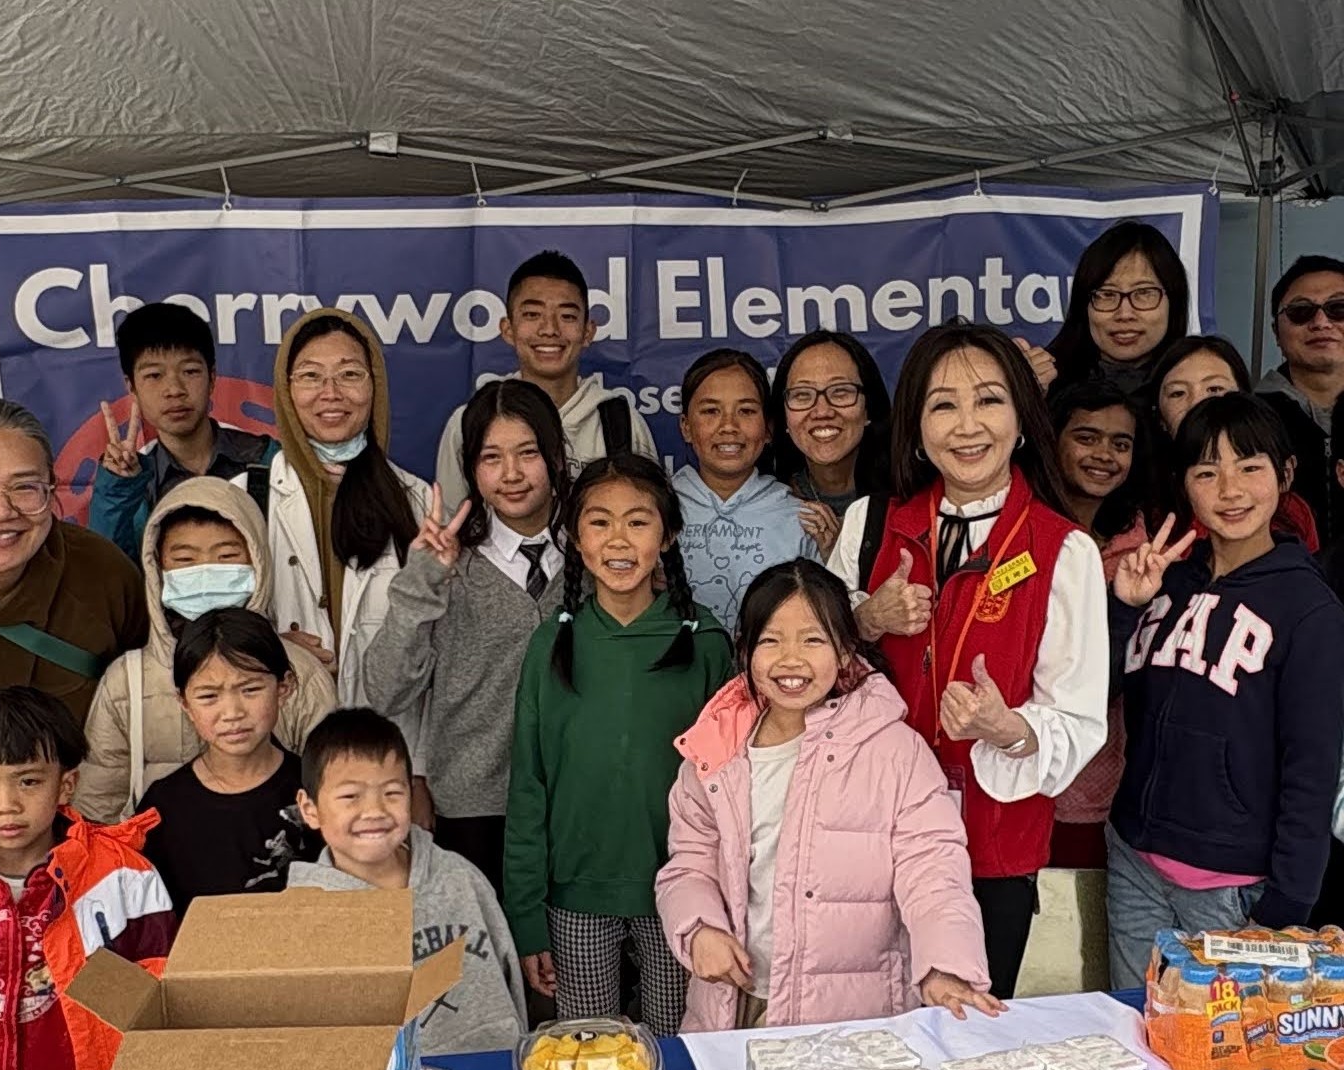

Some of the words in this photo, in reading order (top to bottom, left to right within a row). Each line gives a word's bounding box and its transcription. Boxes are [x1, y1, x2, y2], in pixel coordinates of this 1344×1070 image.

[14, 257, 627, 350] Chrrwod
[657, 257, 1073, 340] Elementa
[1125, 593, 1275, 697] GAP
[1210, 1000, 1238, 1015] PACK
[1213, 980, 1236, 1001] 18
